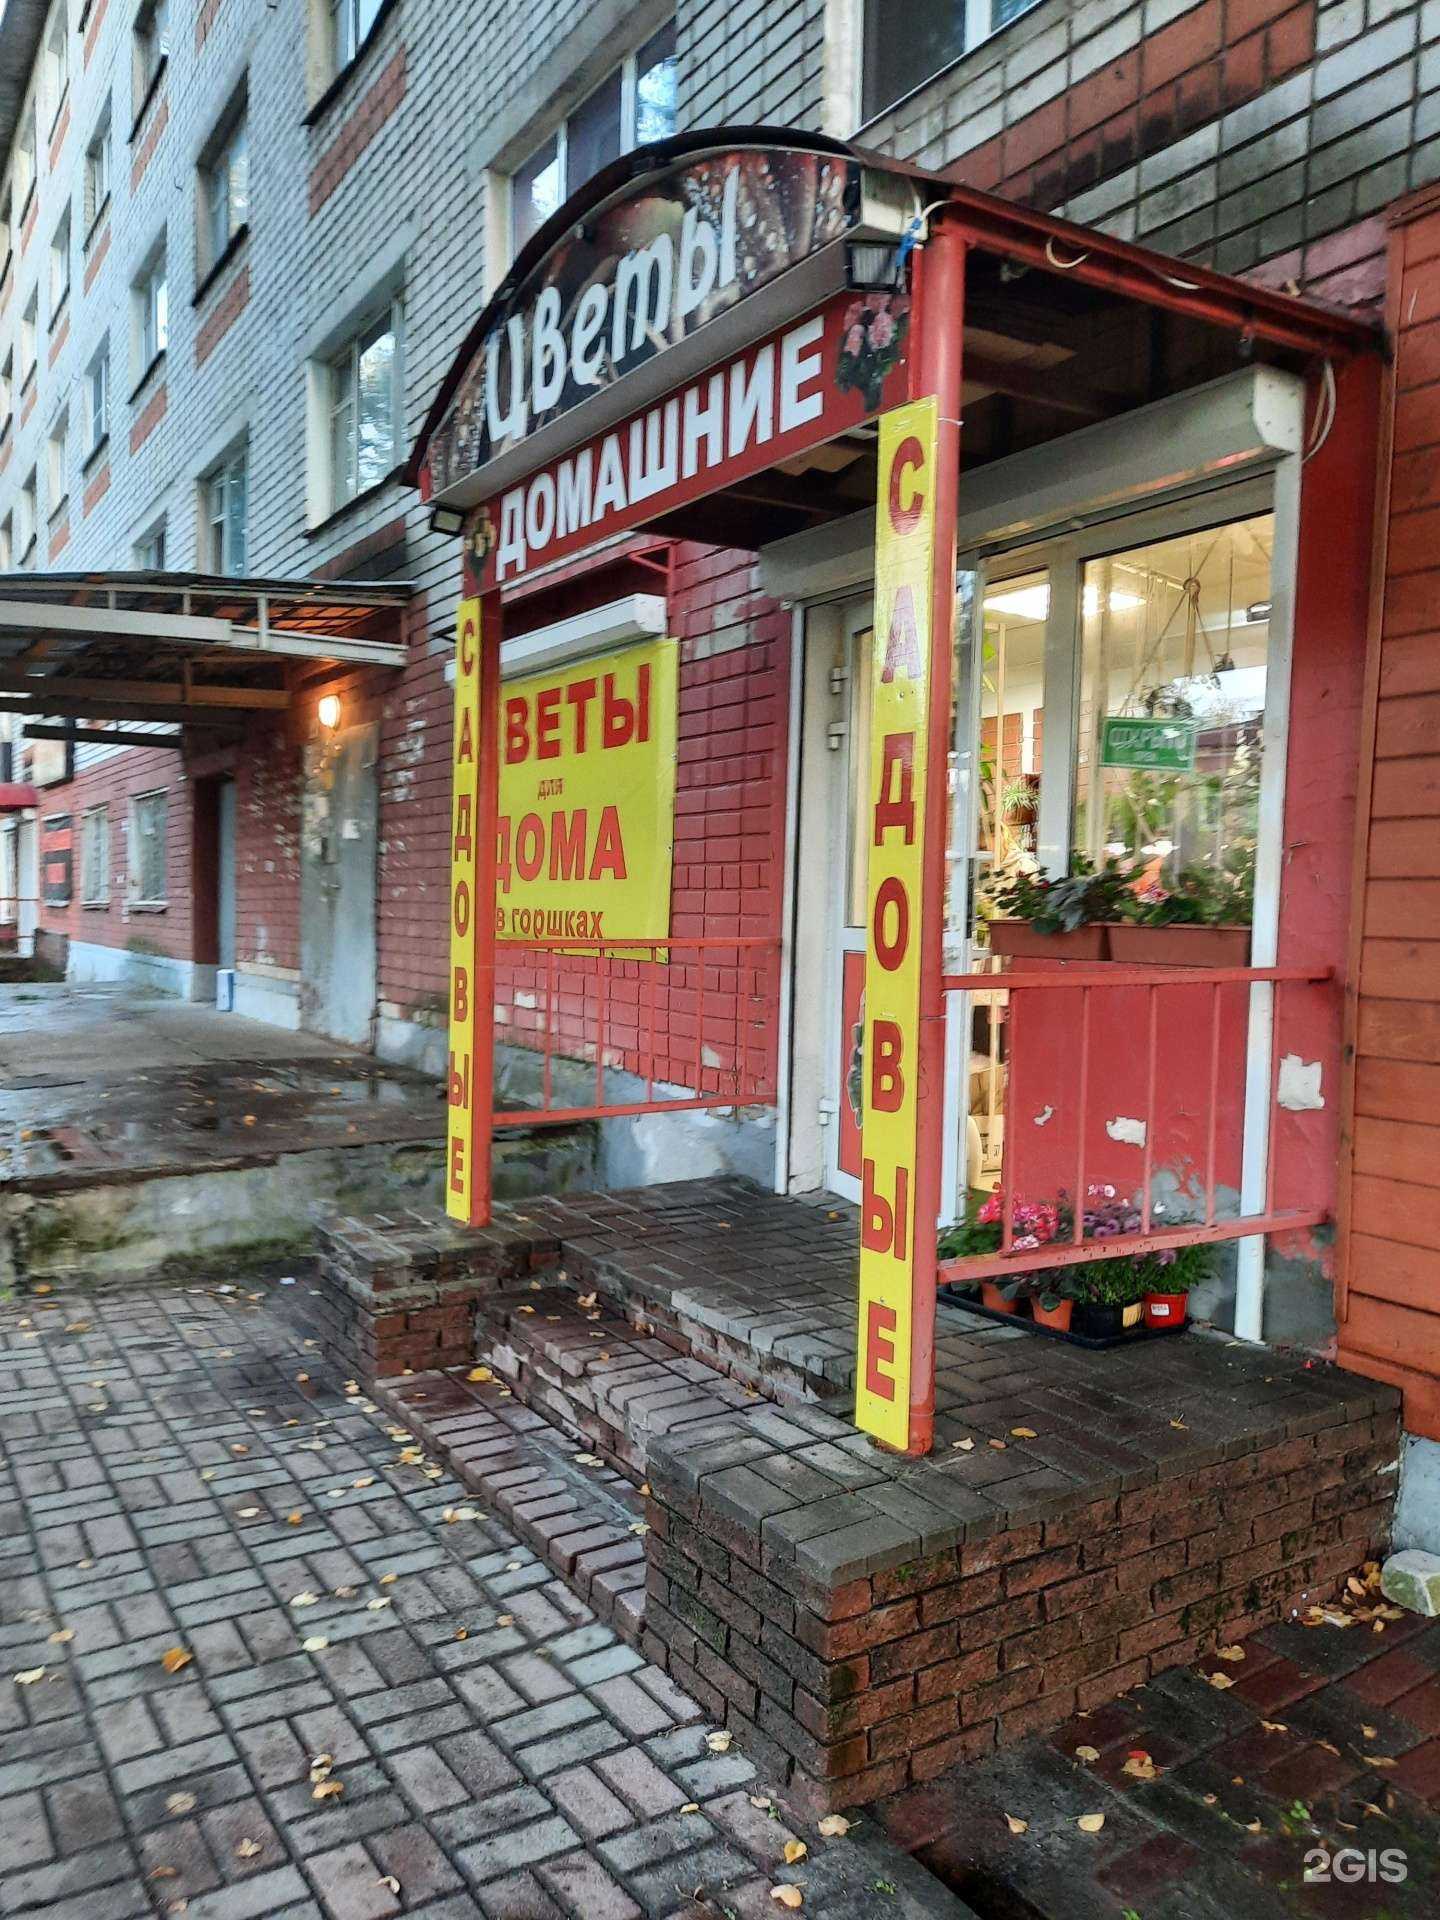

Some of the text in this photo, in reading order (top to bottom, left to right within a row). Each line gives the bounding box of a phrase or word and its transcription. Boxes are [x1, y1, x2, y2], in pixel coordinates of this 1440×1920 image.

[485, 166, 741, 442] Цветы
[495, 315, 825, 581] ДОМАШНИЕ
[505, 662, 651, 765] ВЕТЫ
[537, 777, 564, 800] для
[449, 618, 474, 1194] САДОВЫЕ
[511, 908, 604, 939] горшках
[861, 435, 926, 1403] САДОВЫЕ
